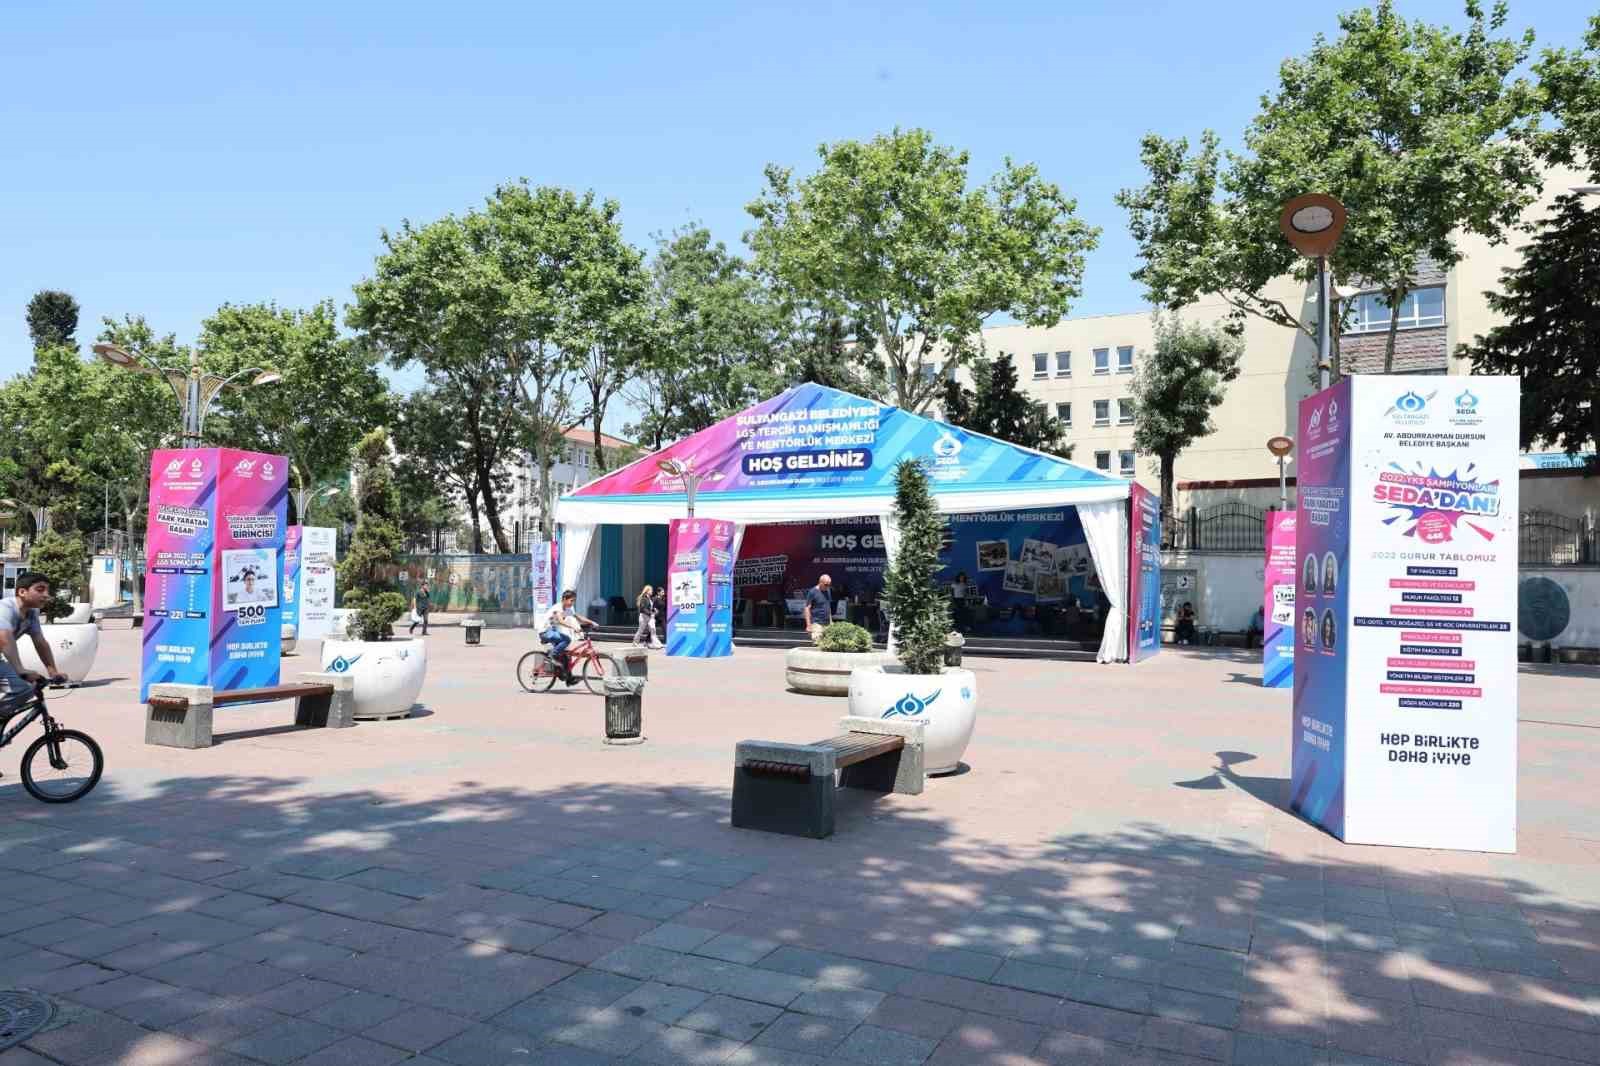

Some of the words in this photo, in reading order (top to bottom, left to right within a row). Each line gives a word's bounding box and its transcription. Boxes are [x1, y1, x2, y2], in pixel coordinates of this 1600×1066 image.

[736, 408, 808, 426] SULTANGAZİ
[810, 406, 880, 419] BELEDİYESİ
[736, 429, 755, 438] LGS
[757, 425, 796, 436] TERCİH
[799, 418, 880, 433] DANIŞMANLIĞI
[740, 441, 754, 450] VE
[757, 436, 823, 449] MENTÖRLÜK
[825, 432, 875, 445] MERKEZİ
[1396, 432, 1454, 440] ABDURRAHMAN
[748, 456, 783, 472] HOŞ
[786, 450, 865, 469] GELDİNİZ
[1374, 484, 1497, 513] SEDA'DAN!
[176, 517, 208, 526] YARATAN
[950, 511, 1015, 523] MENTÖRLÜK
[1017, 511, 1065, 522] MERKEZİ
[821, 535, 858, 550] HOŞ
[1400, 552, 1436, 561] GURUR
[1440, 553, 1497, 562] TABLOMUZ
[239, 605, 264, 618] 500
